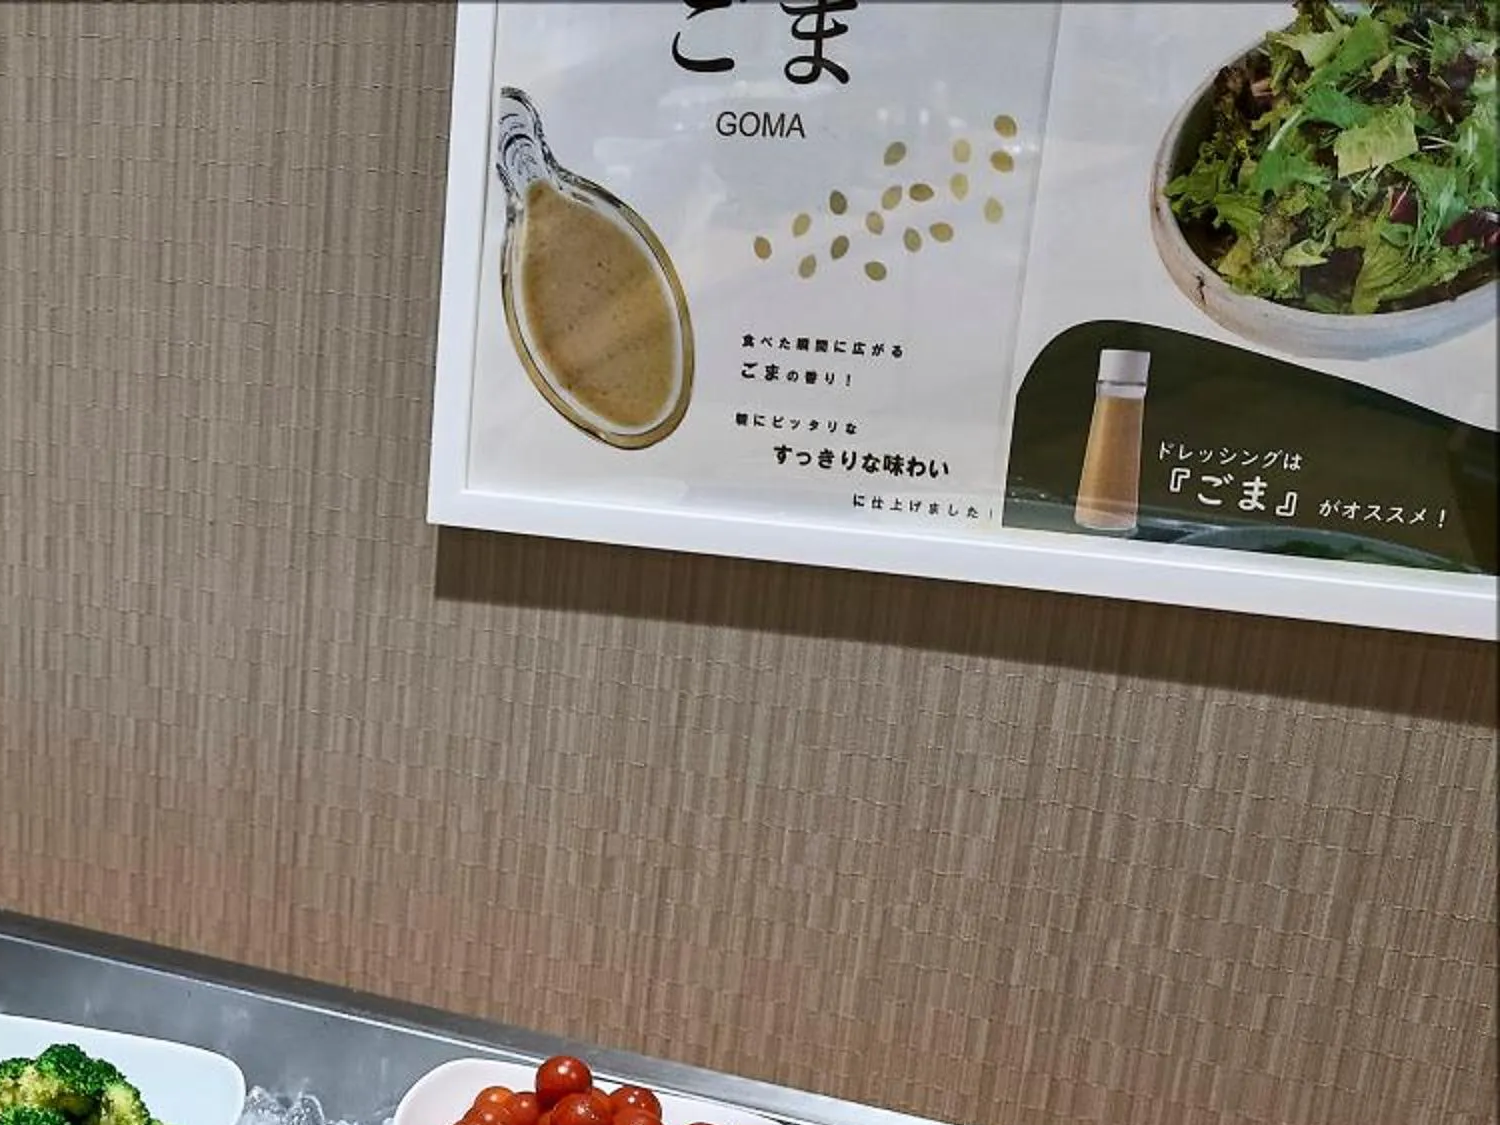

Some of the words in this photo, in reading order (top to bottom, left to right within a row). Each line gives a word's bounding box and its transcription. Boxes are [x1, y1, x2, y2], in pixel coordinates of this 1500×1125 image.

[716, 111, 806, 138] GOMA
[773, 444, 949, 479] すっきりな味わい
[1158, 440, 1303, 471] ドレッシングは
